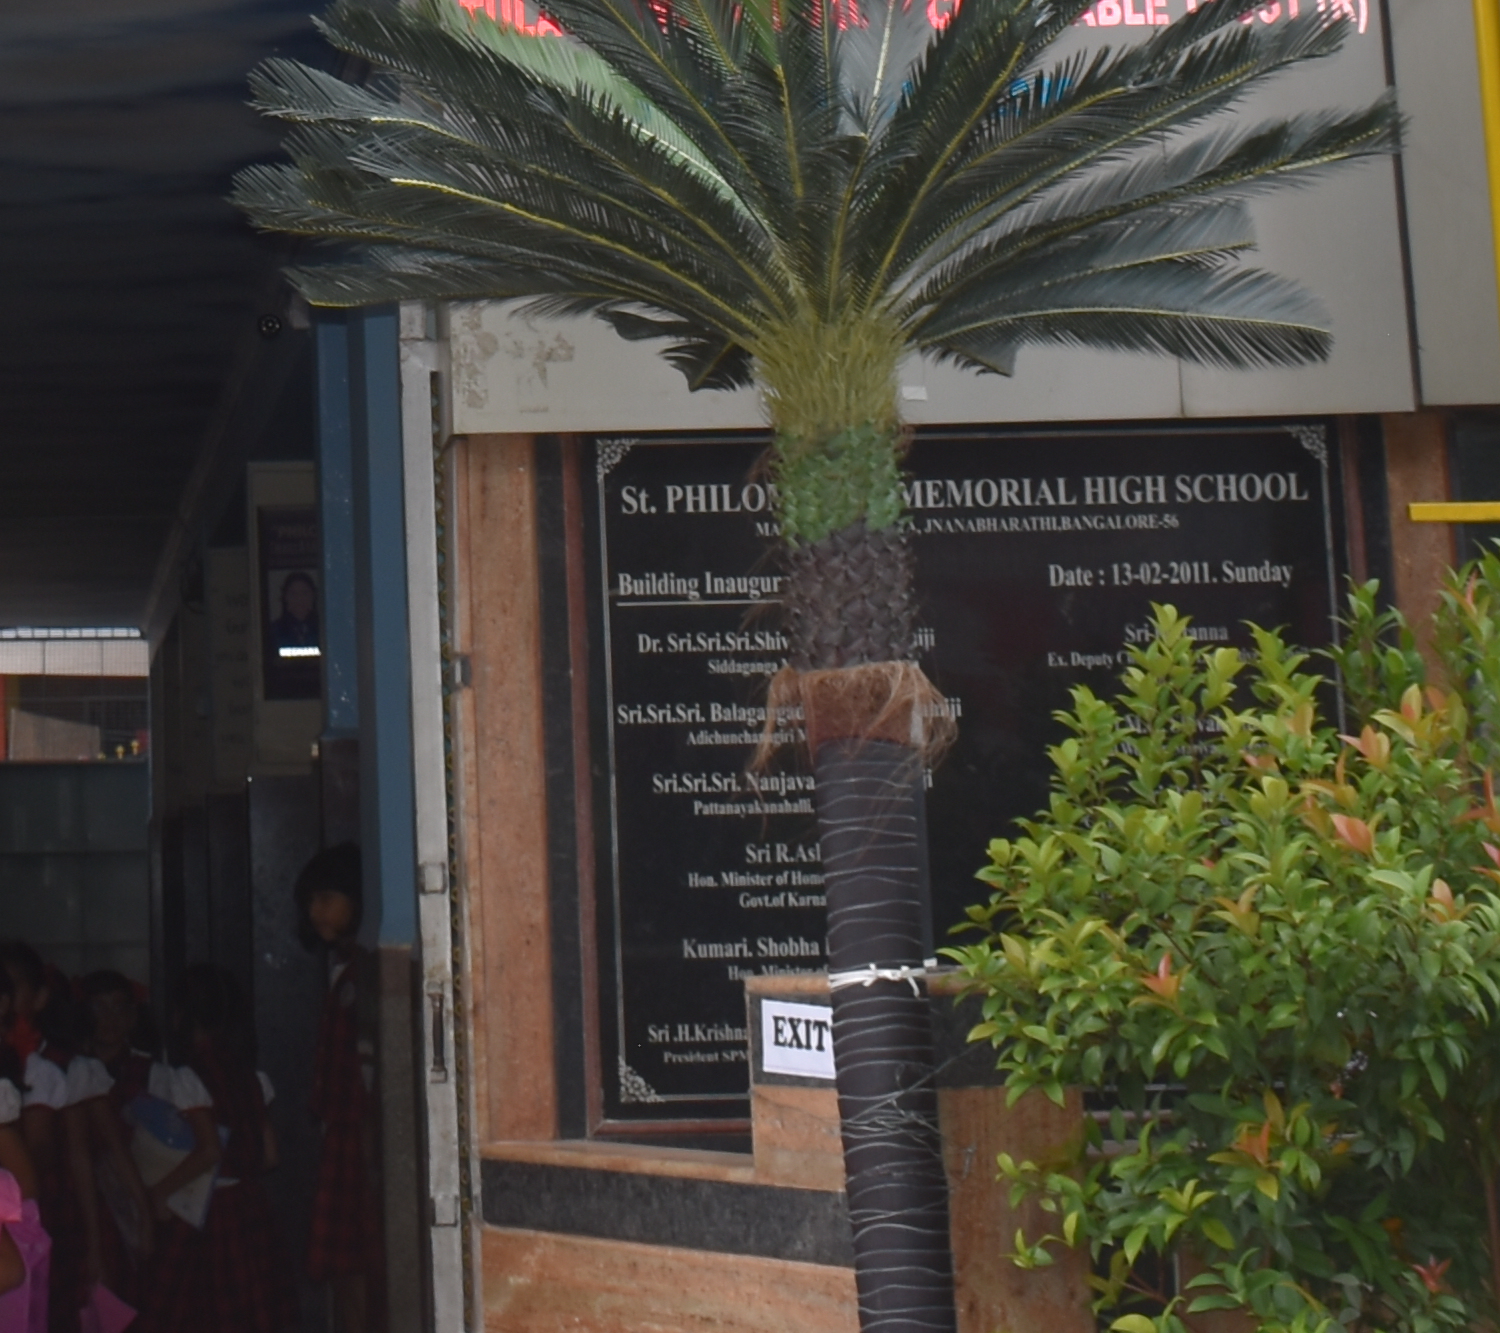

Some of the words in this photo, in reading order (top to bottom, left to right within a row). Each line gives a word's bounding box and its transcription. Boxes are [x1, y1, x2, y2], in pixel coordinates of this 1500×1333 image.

[620, 484, 658, 515] St.
[899, 476, 1078, 509] MEMORIAL
[1083, 474, 1169, 506] HIGH
[1175, 471, 1310, 504] SCHOOL
[617, 571, 701, 601] Building
[1047, 563, 1095, 589] Date
[1221, 560, 1295, 589] Sunday
[637, 633, 664, 654] Dr.
[744, 842, 771, 864] Sri
[687, 872, 719, 889] Hon.
[720, 870, 773, 889] Minister
[775, 870, 791, 888] of
[681, 936, 754, 959] Kumari.
[756, 935, 821, 958] Shobha
[647, 1023, 669, 1044] Sri
[771, 1014, 831, 1054] EXIT
